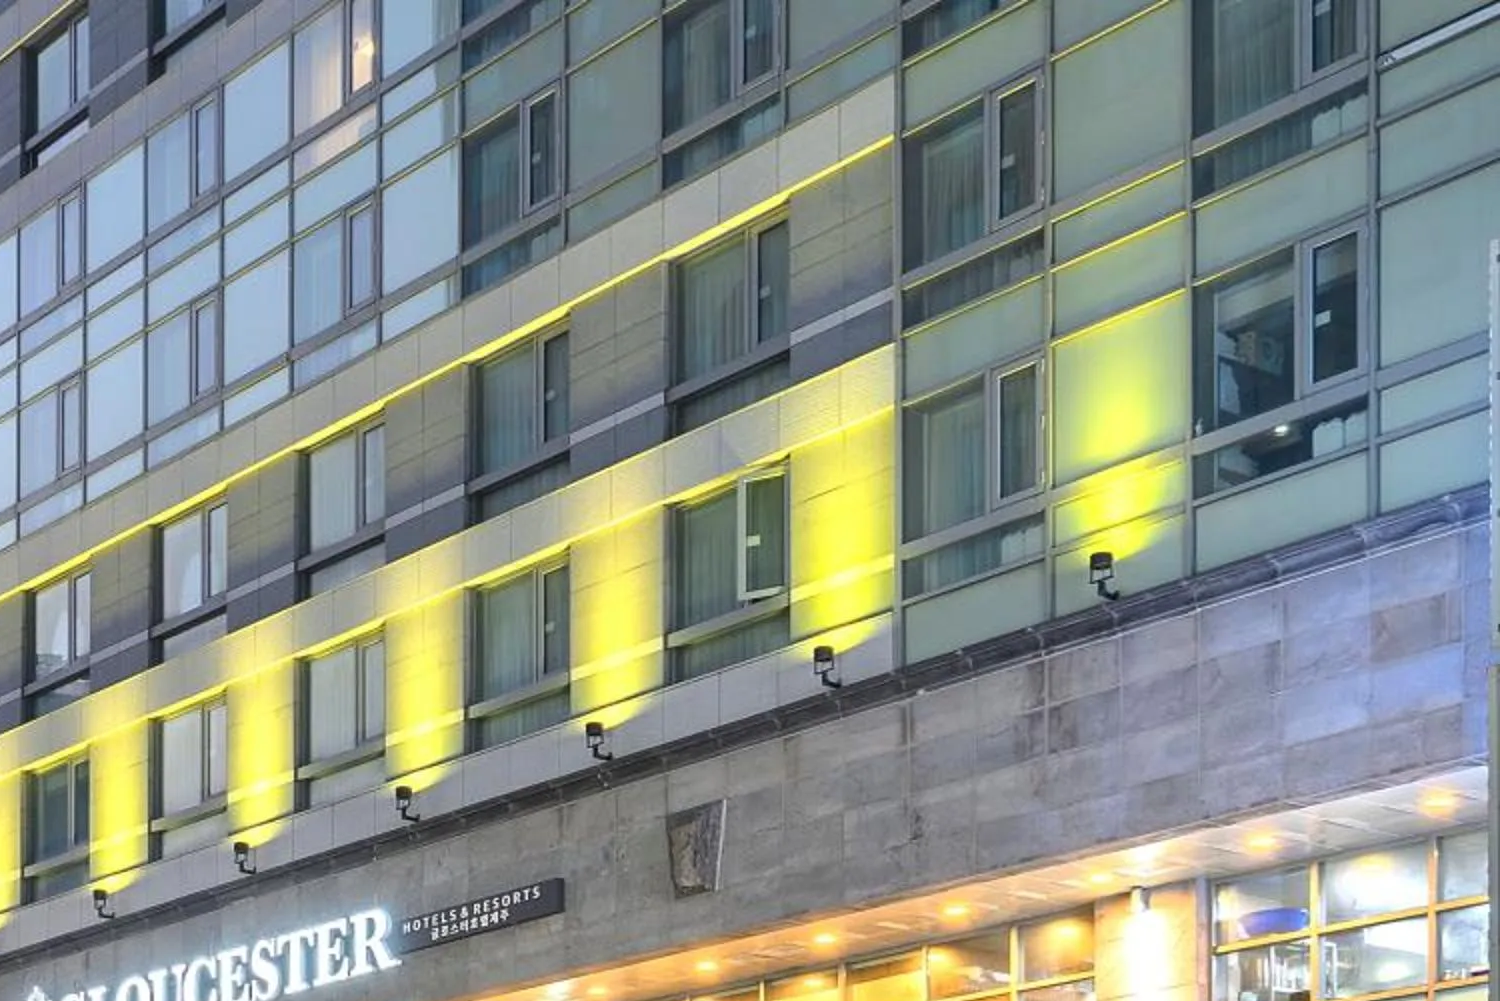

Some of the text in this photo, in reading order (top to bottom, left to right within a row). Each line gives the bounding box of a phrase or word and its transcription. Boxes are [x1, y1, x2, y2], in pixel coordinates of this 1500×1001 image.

[403, 885, 541, 934] HOTELS & RESORTS
